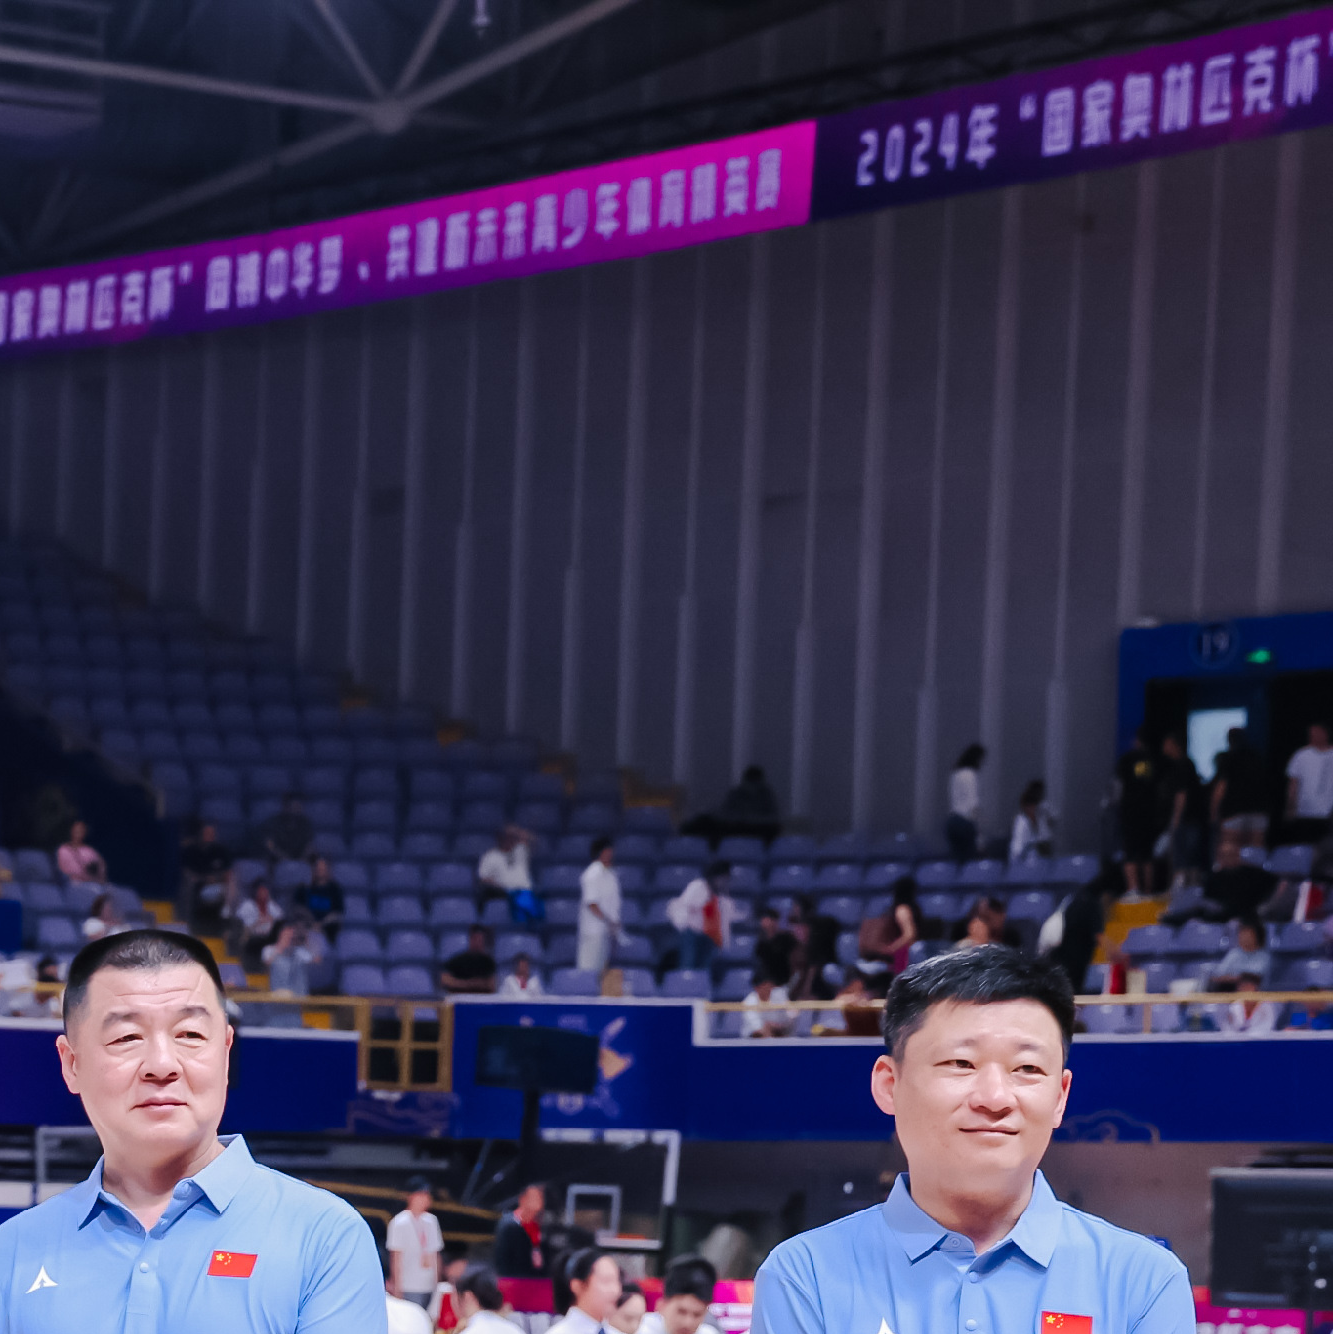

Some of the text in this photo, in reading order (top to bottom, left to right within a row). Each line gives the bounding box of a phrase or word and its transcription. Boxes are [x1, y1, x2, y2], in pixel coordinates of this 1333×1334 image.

[856, 34, 1333, 186] 2024年“国家奥林匹克杯
